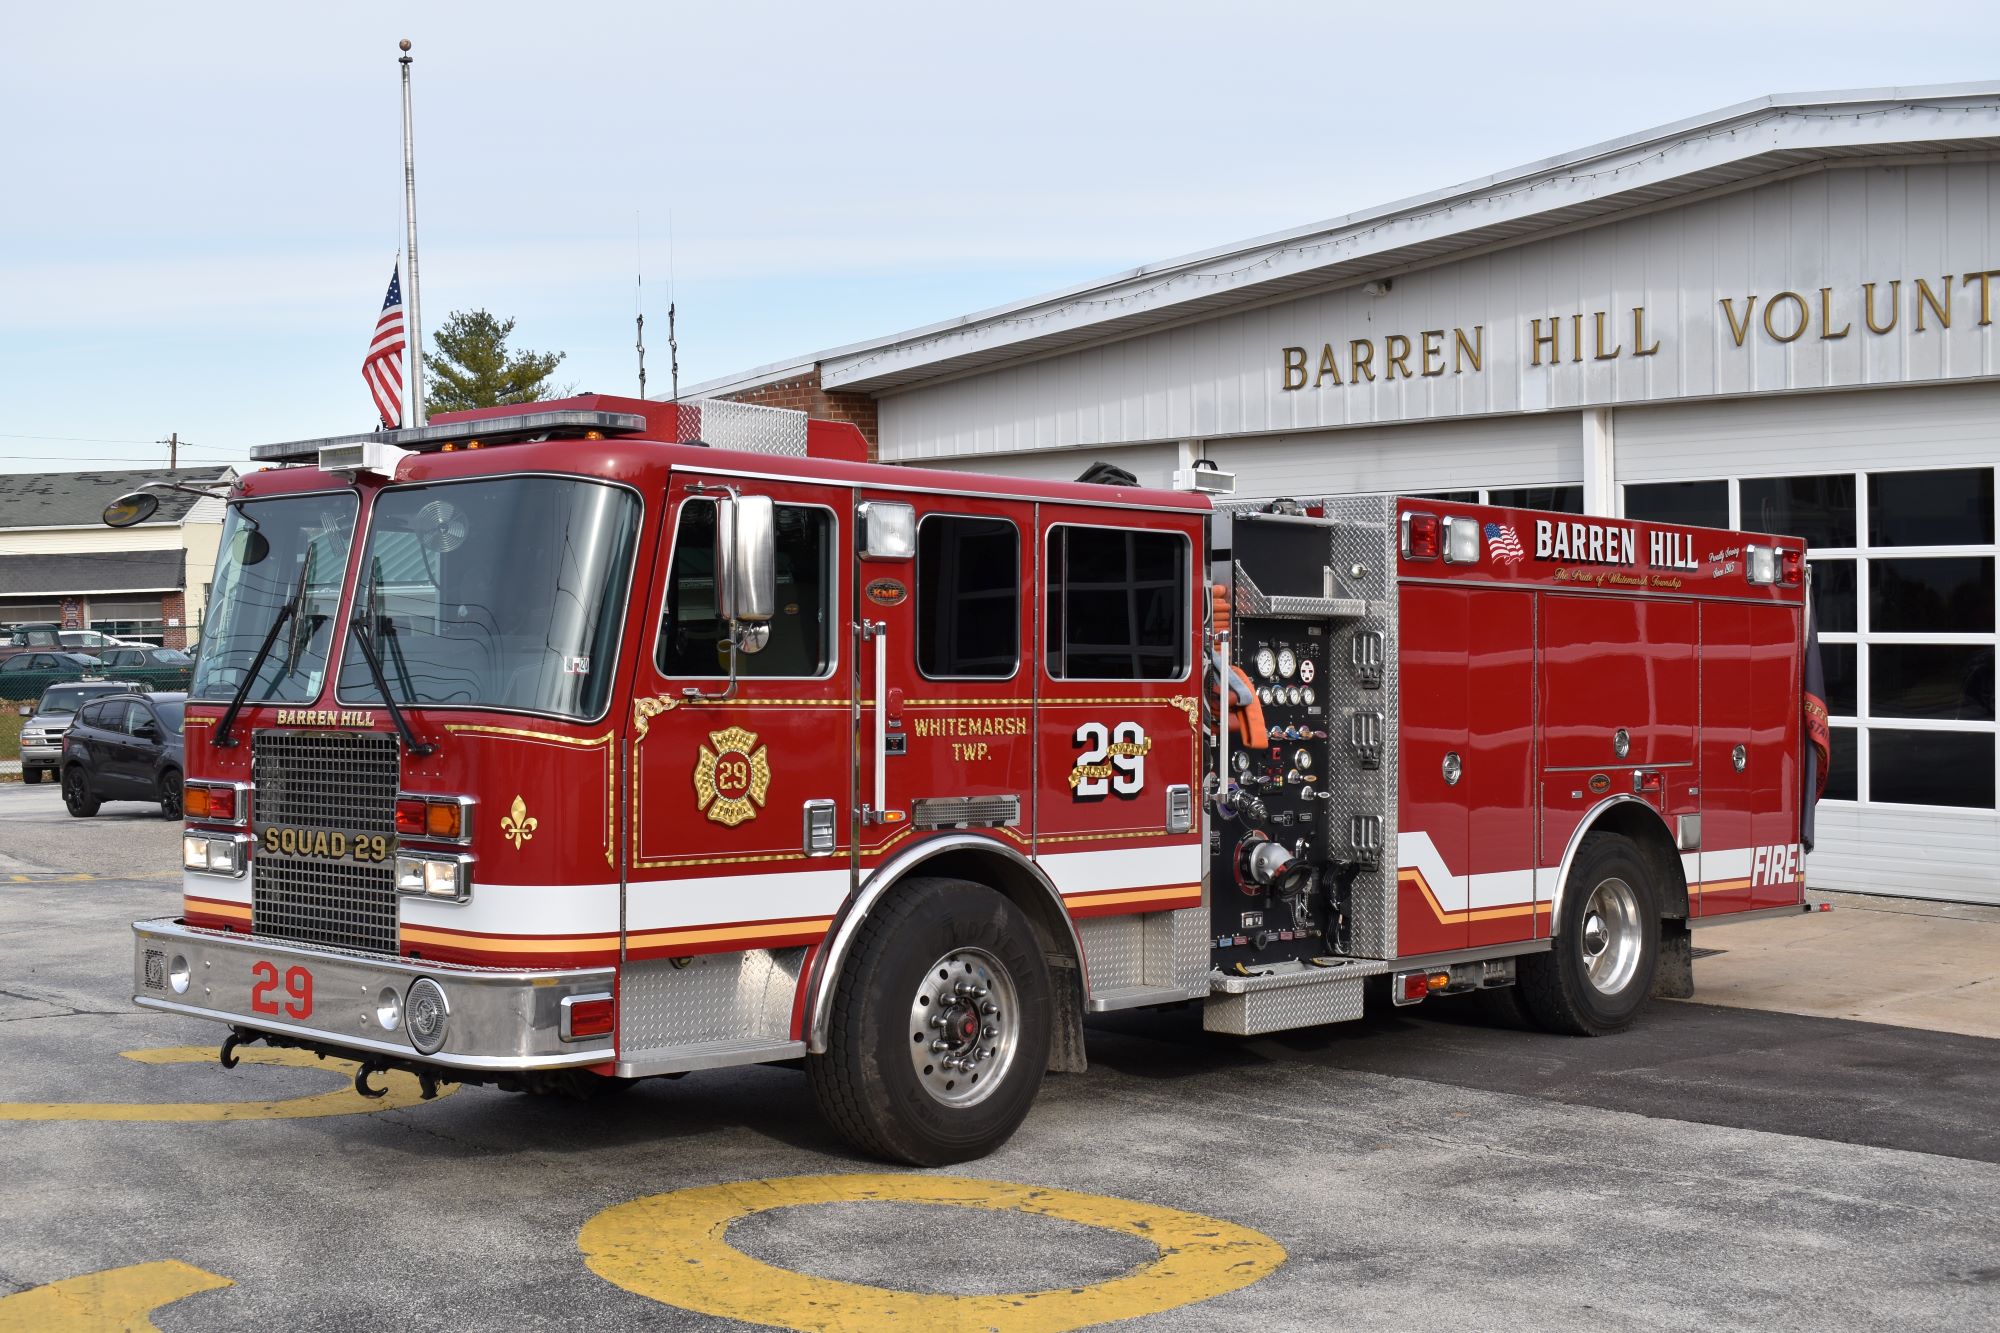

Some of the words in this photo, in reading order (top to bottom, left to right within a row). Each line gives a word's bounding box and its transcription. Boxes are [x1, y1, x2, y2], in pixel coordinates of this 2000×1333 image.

[1282, 325, 1483, 390] BARREN
[1531, 307, 1660, 366] HILL
[1535, 519, 1636, 564] BARREN
[1649, 530, 1699, 569] HILL
[1553, 567, 1569, 582] The
[1571, 569, 1593, 582] Pride
[1595, 571, 1605, 588] of
[1607, 571, 1648, 586] Whitemarsh
[1650, 575, 1683, 589] Township
[873, 588, 899, 598] KME
[277, 709, 338, 726] BARREN
[340, 711, 375, 727] HILL
[914, 717, 1027, 737] WHITEMARSH
[952, 742, 992, 761] TWP.
[1076, 721, 1145, 797] 29
[719, 761, 747, 789] 29
[1076, 767, 1109, 777] SQUAD
[265, 827, 346, 859] SQUAD
[353, 834, 387, 862] 29
[1752, 844, 1798, 887] FIRE
[252, 960, 314, 1021] 29
